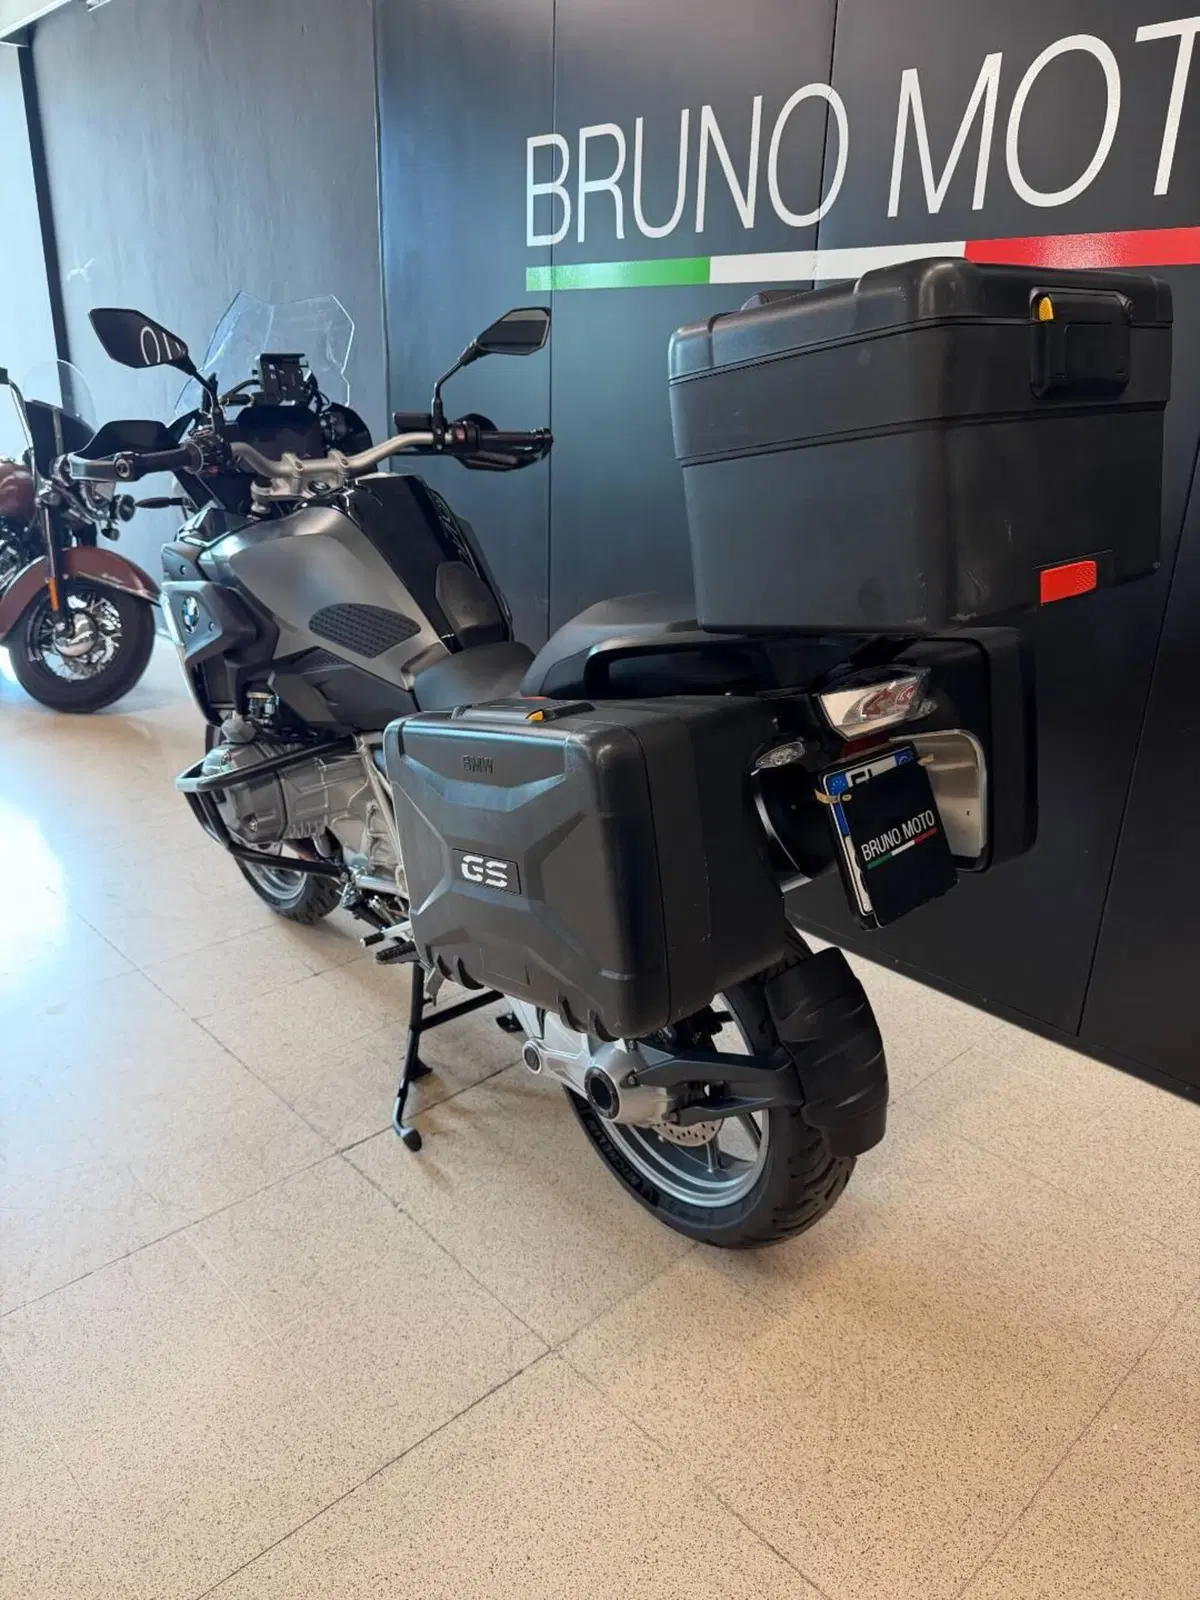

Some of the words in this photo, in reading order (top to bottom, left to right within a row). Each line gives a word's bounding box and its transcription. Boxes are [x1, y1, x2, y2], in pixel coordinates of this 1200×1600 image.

[526, 83, 849, 247] BRUNO
[887, 16, 1200, 217] MOT
[463, 755, 494, 774] BMW
[860, 828, 901, 862] BRUNO
[901, 809, 935, 839] MOTO
[461, 854, 508, 888] GS
